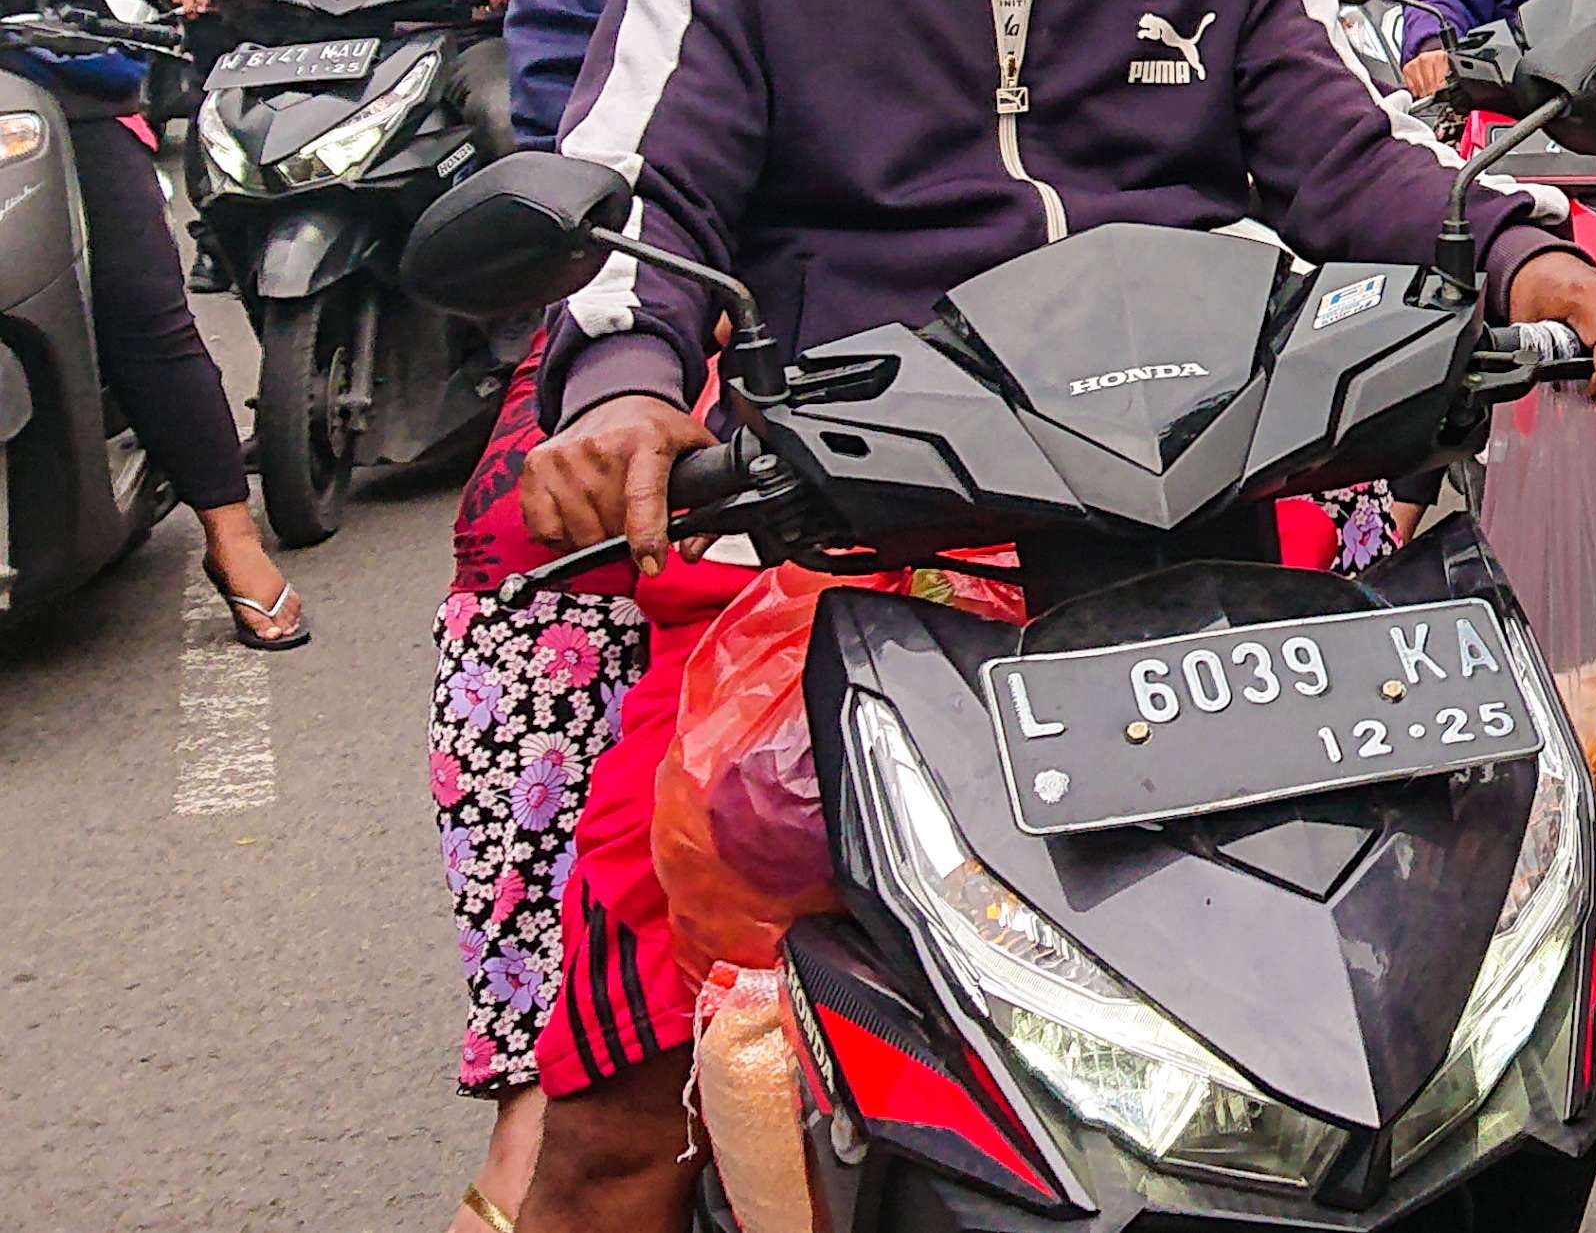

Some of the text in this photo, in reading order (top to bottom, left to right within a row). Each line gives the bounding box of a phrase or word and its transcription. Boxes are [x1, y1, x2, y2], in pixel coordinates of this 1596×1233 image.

[219, 40, 371, 70] W 6747 NAU
[1127, 60, 1191, 84] PUMA
[437, 143, 475, 176] HONDA
[1069, 362, 1211, 397] HONDA
[1007, 617, 1500, 739] L 6039 KA
[784, 970, 836, 1097] HONDA
